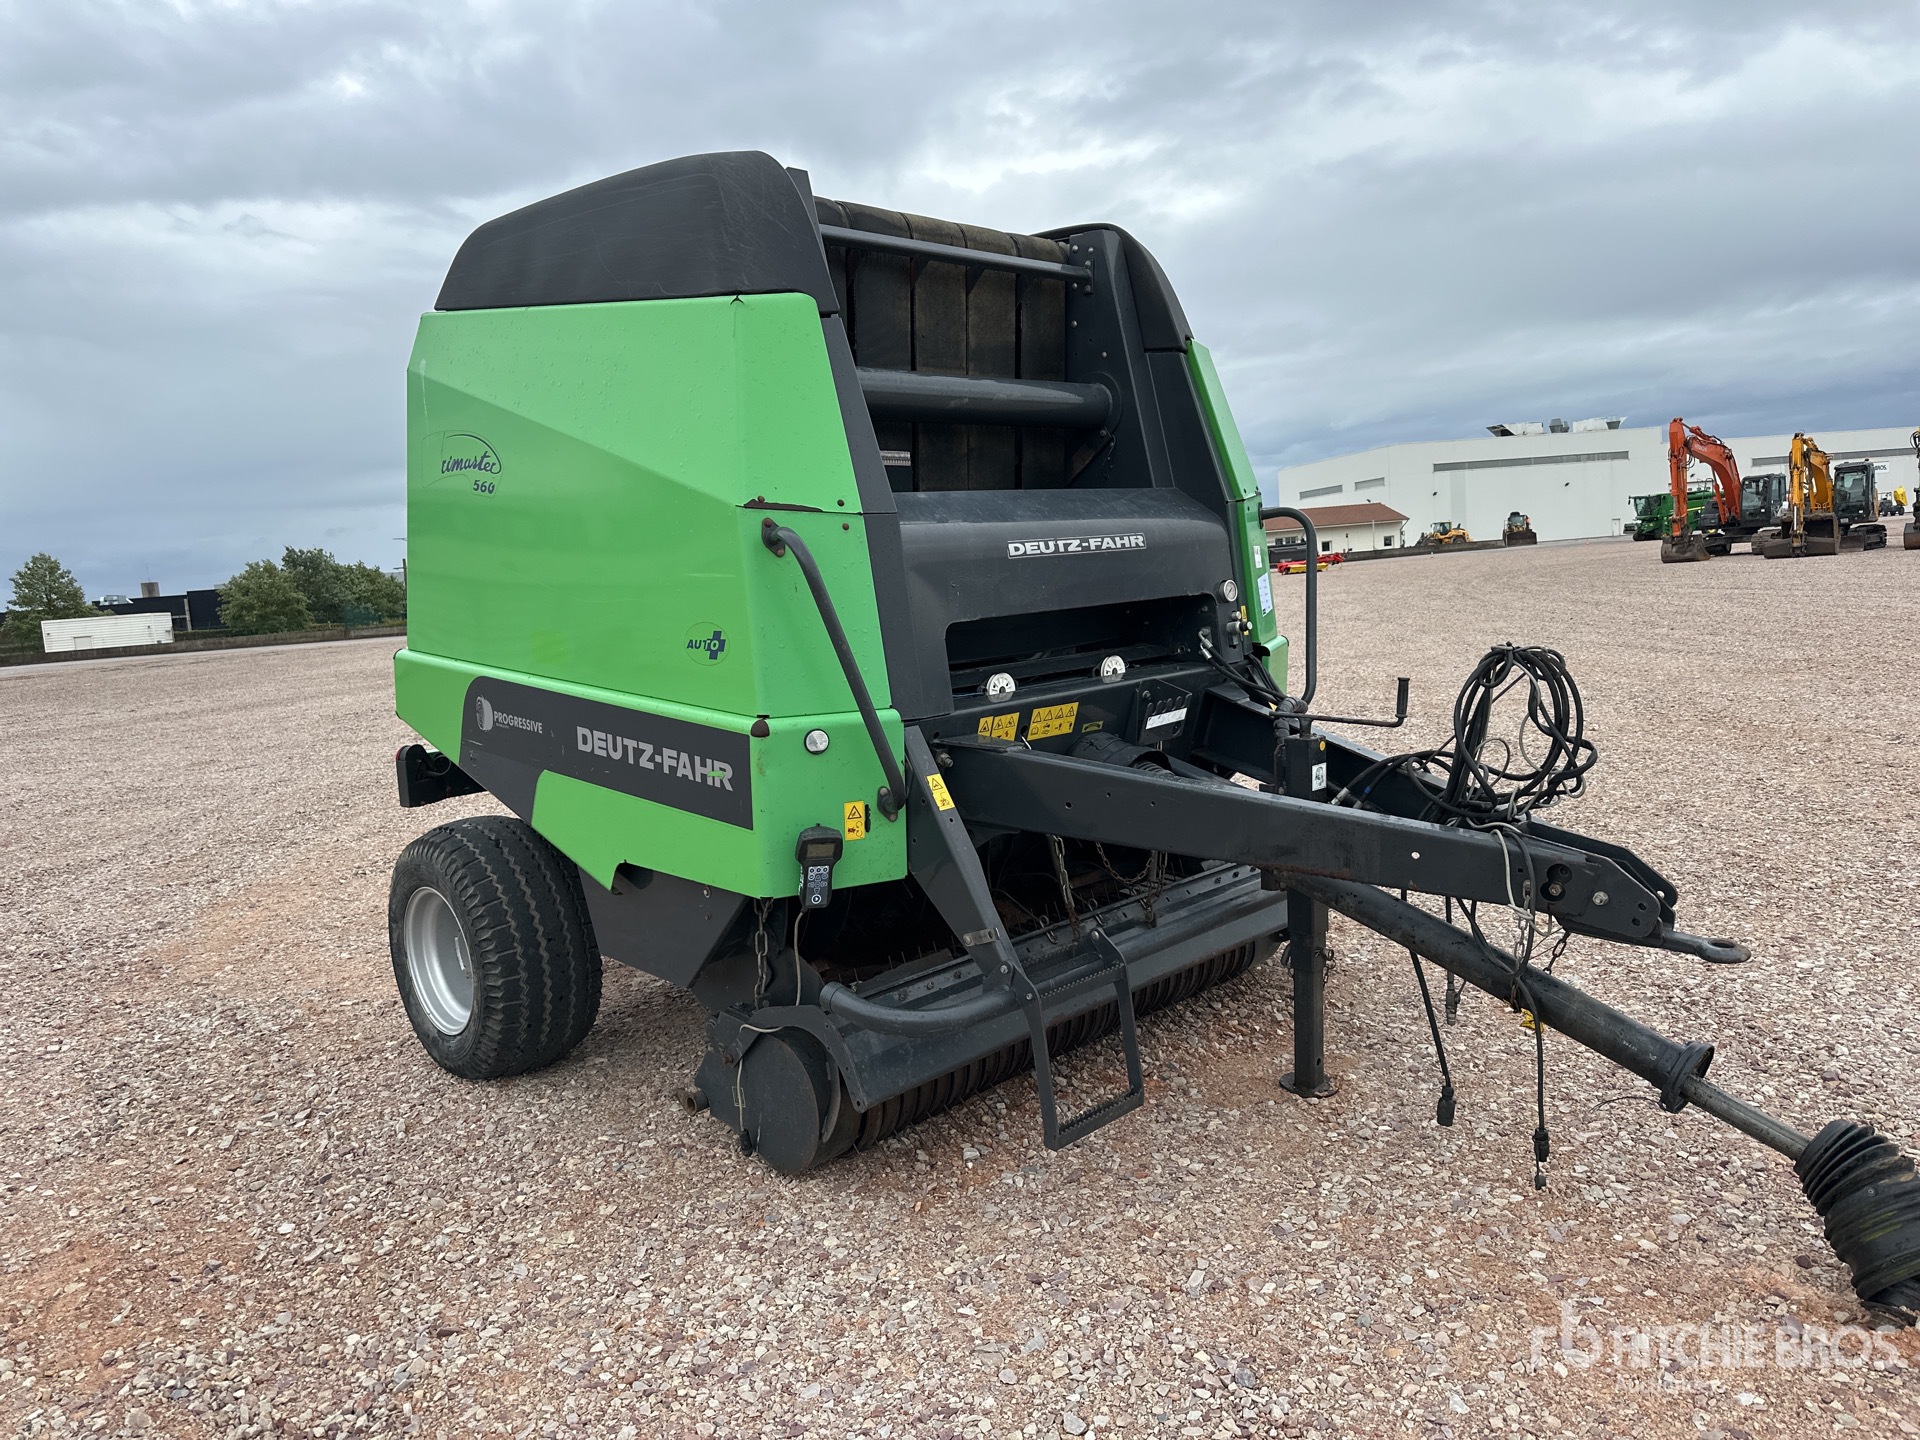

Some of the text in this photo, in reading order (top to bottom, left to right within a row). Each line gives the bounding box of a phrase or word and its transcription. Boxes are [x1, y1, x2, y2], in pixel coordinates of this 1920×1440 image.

[473, 480, 495, 494] 560
[1008, 535, 1145, 556] DEUTZ-FAHR
[494, 710, 543, 734] PROGRESSIVE
[576, 726, 734, 792] DEUTZ-FAHR
